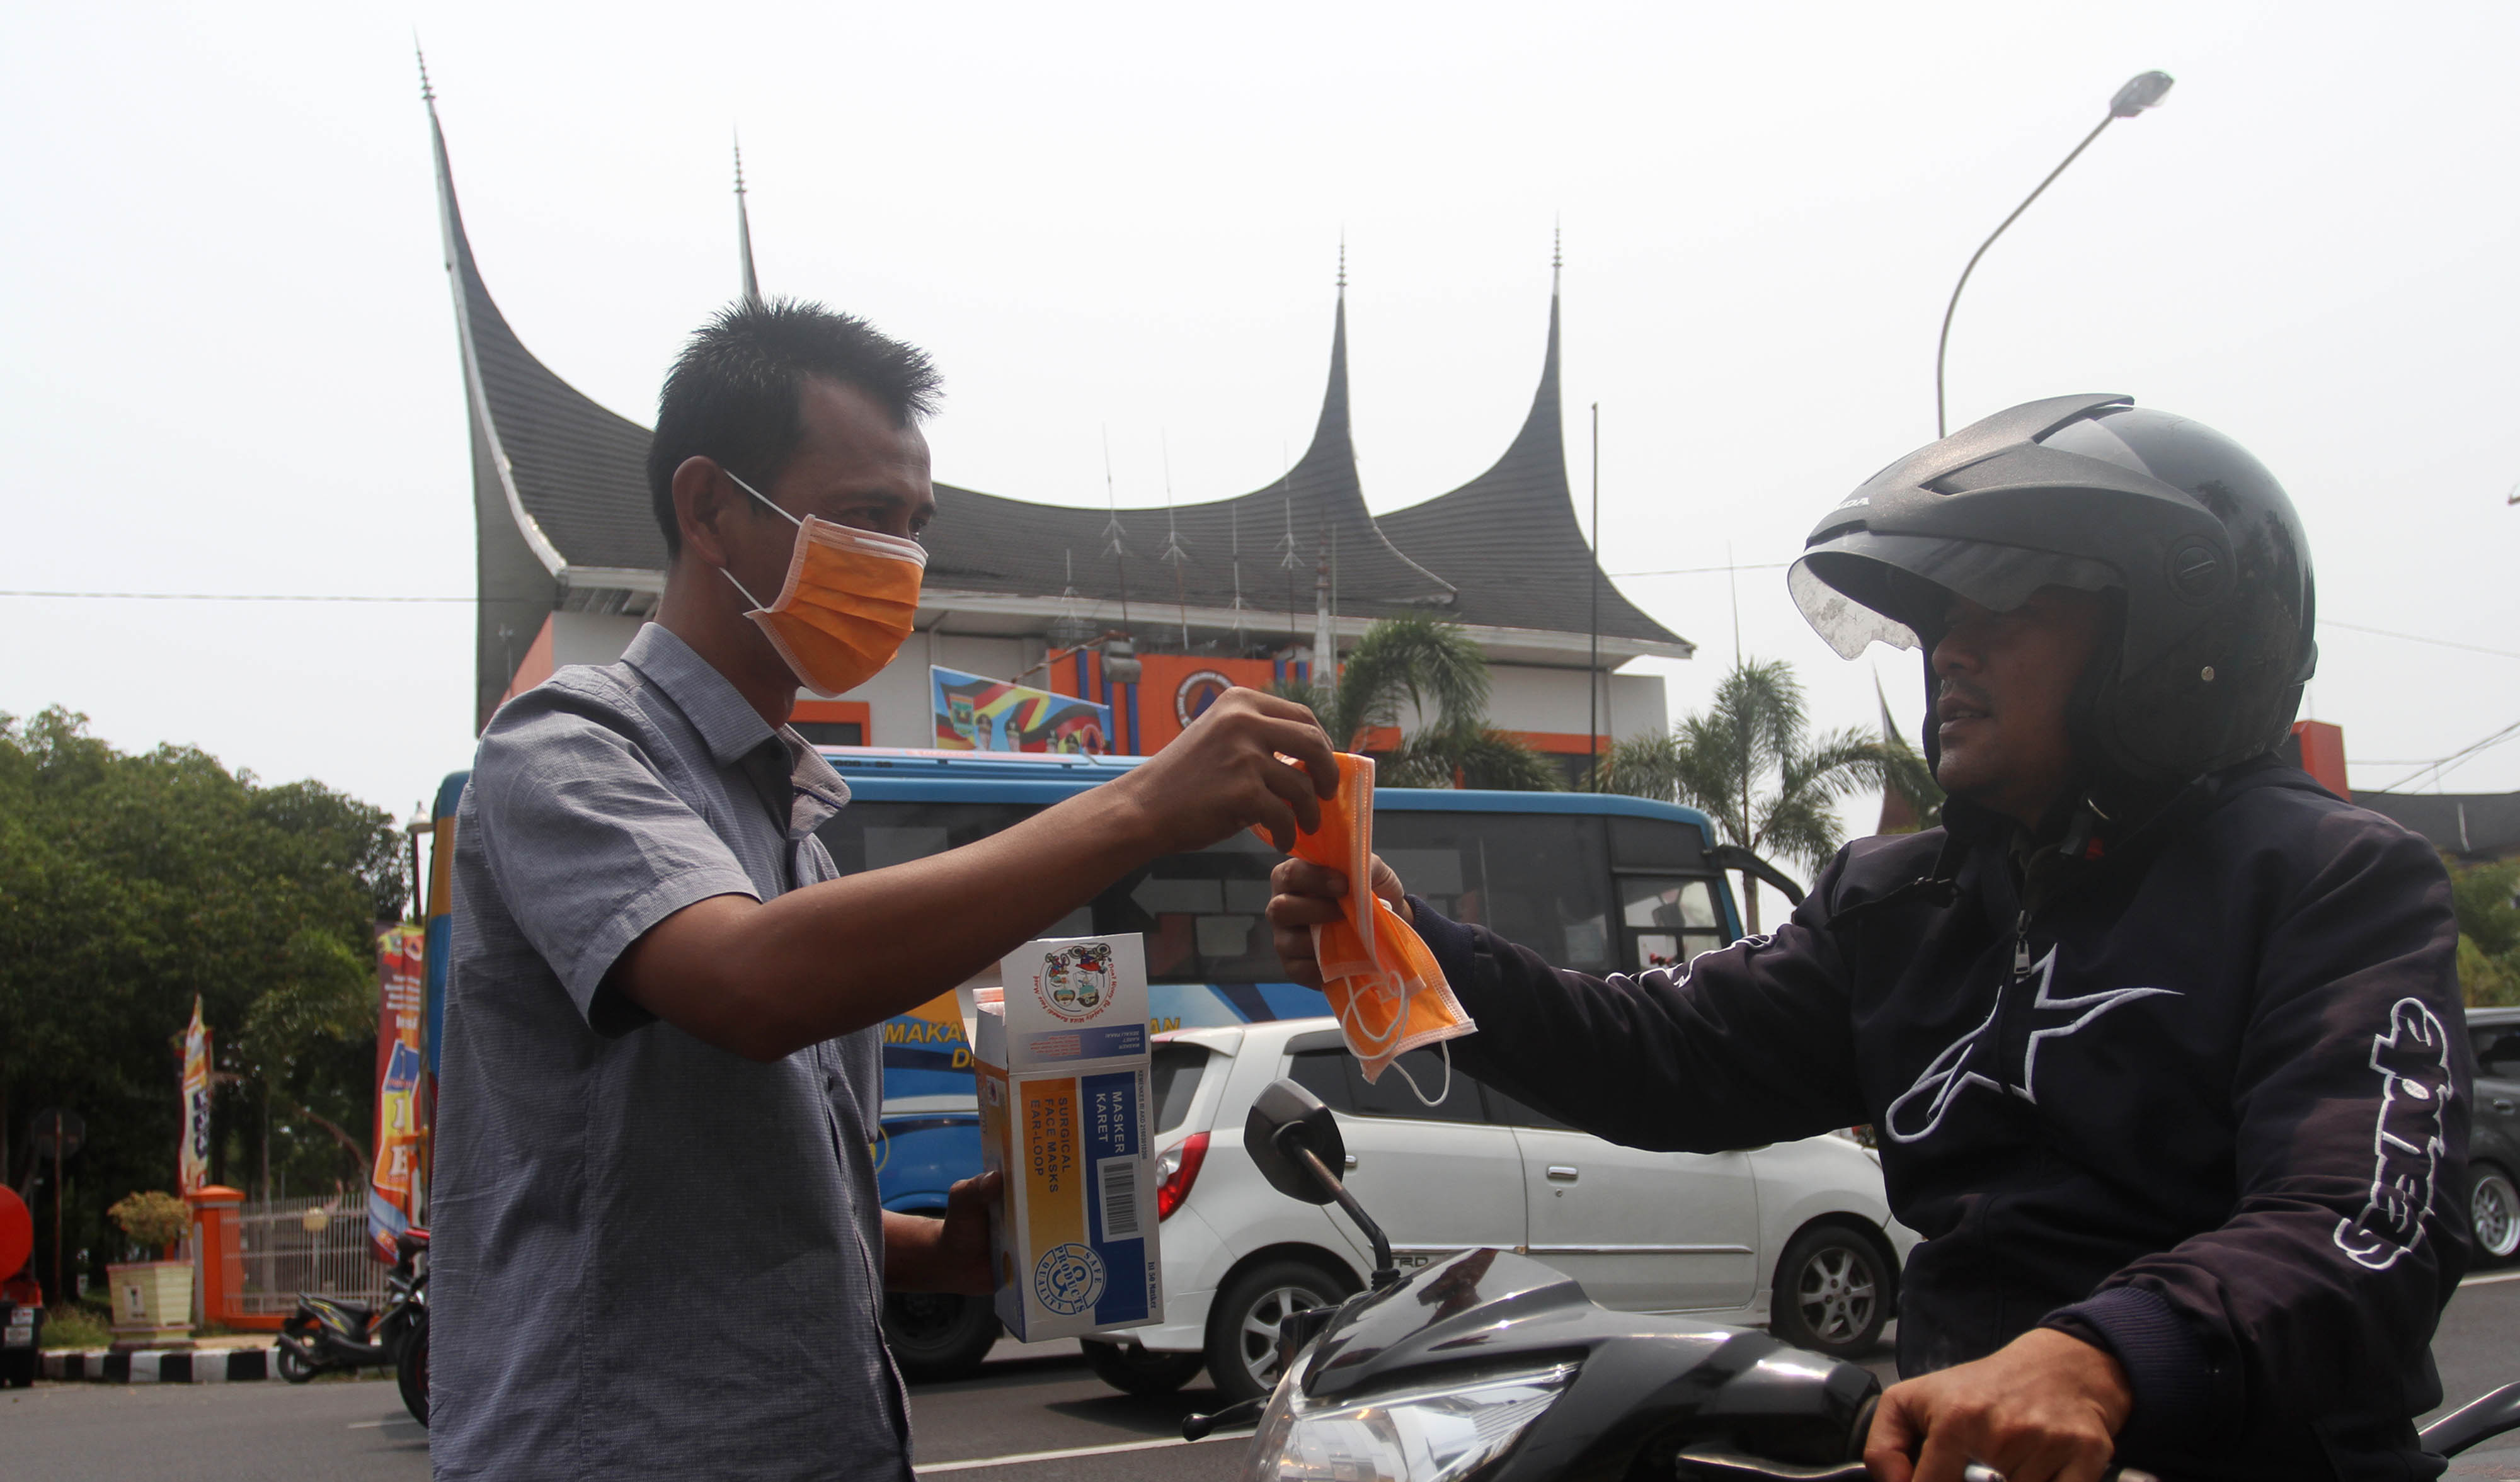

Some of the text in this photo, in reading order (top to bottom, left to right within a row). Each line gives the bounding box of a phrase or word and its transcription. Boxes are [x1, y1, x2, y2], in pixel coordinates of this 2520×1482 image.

[883, 1022, 968, 1044] MAKA
[952, 1047, 975, 1069] D
[1031, 1100, 1044, 1176] EAR-LOOP
[1058, 1097, 1070, 1173] SURGICAL
[1096, 1093, 1108, 1142] KARET
[1112, 1091, 1125, 1153] MASKER
[1045, 1098, 1058, 1193] FACE MASKS
[1038, 1262, 1064, 1310] QUALITY
[1055, 1245, 1085, 1313] PRODUCTS
[1084, 1251, 1102, 1284] SAFE
[1149, 1272, 1155, 1282] 50
